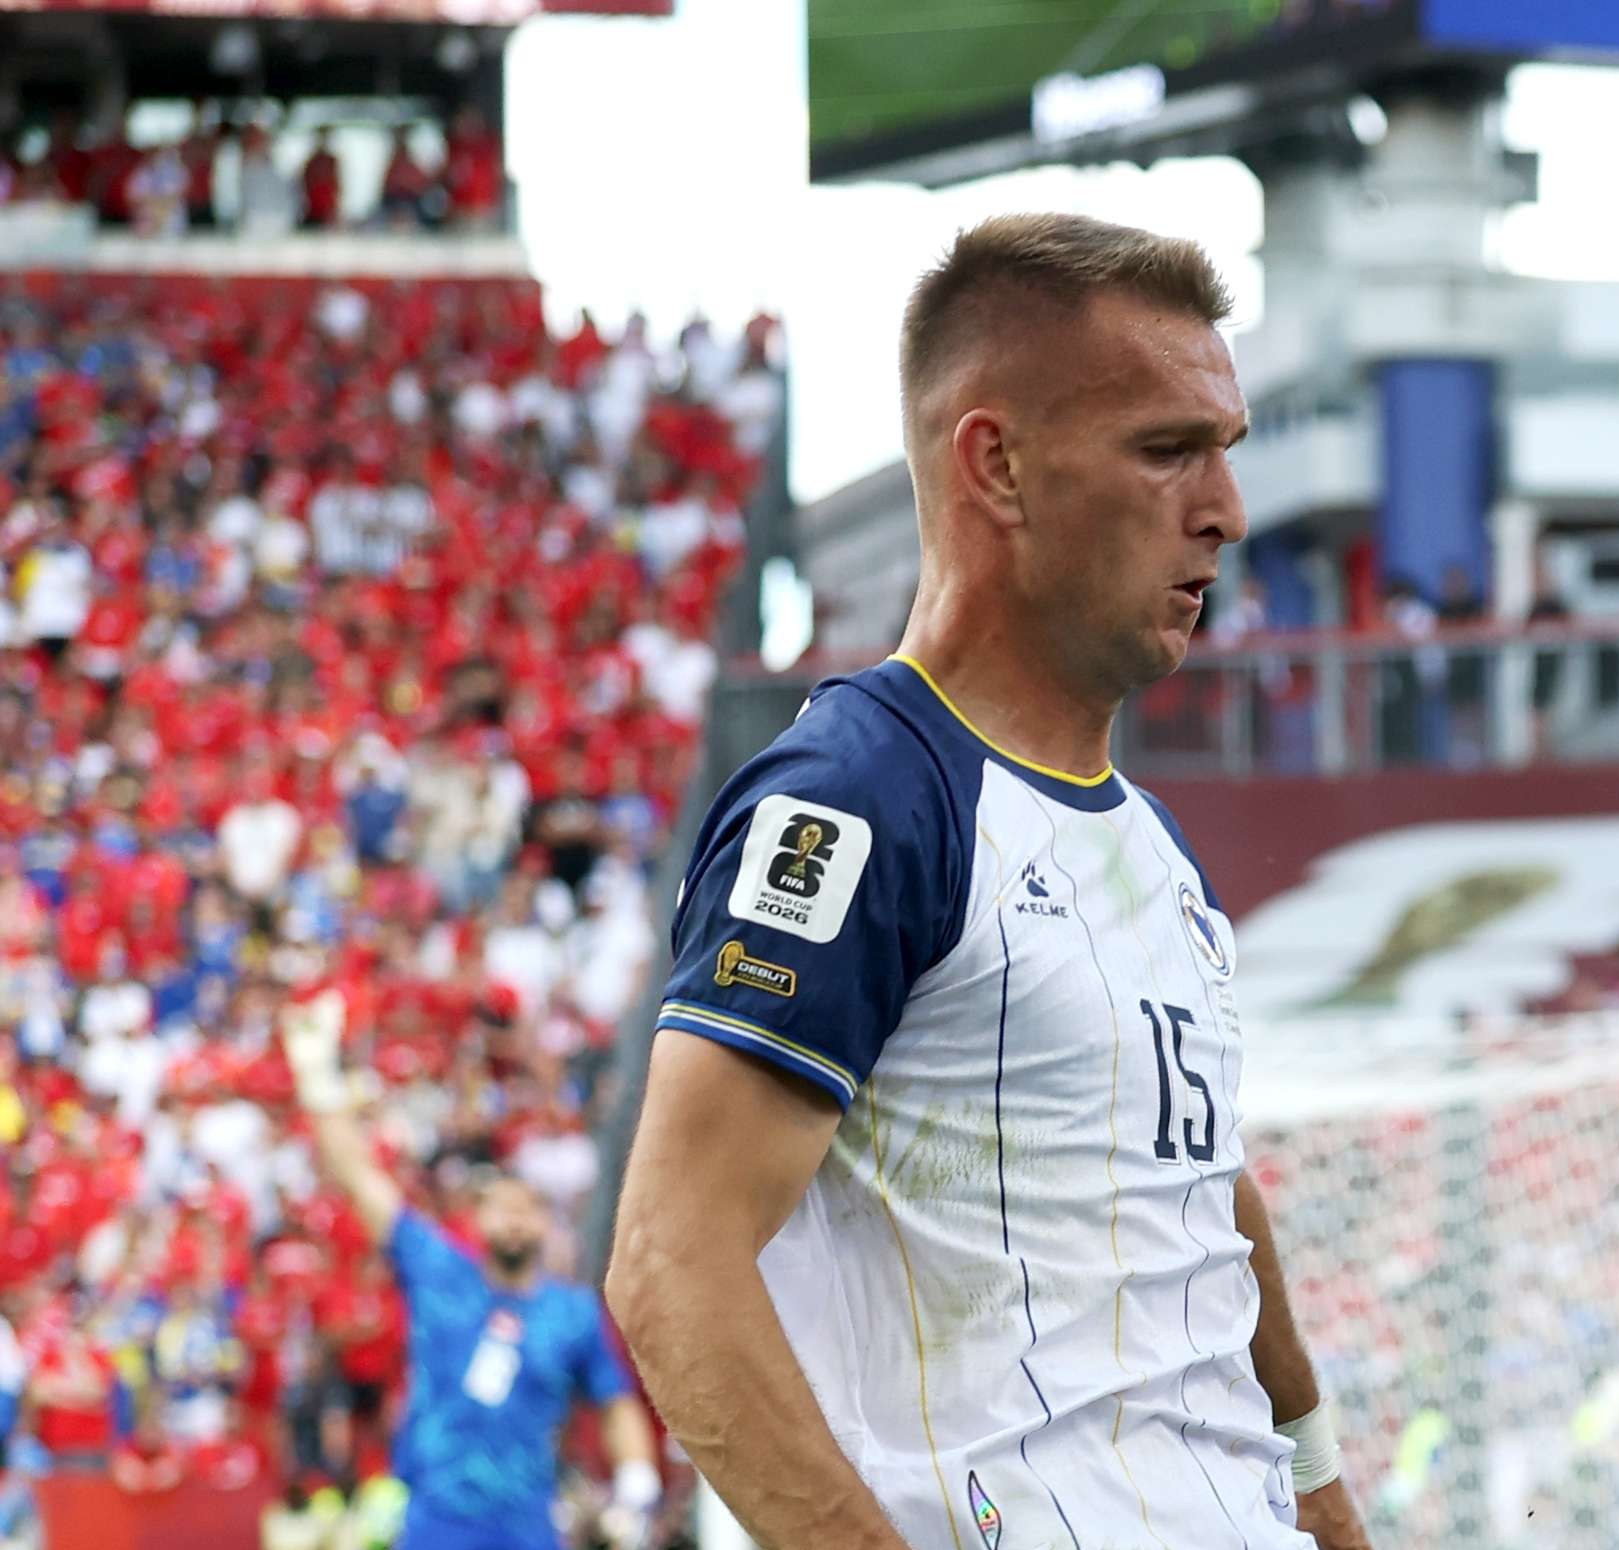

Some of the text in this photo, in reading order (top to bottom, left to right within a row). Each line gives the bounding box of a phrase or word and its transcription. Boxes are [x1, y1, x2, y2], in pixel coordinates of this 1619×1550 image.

[779, 873, 805, 891] FIFA
[754, 900, 809, 925] 2026
[760, 891, 813, 912] WORLD CUP
[1015, 902, 1070, 919] KELME
[737, 961, 790, 984] DEBUT
[1140, 999, 1217, 1164] 15
